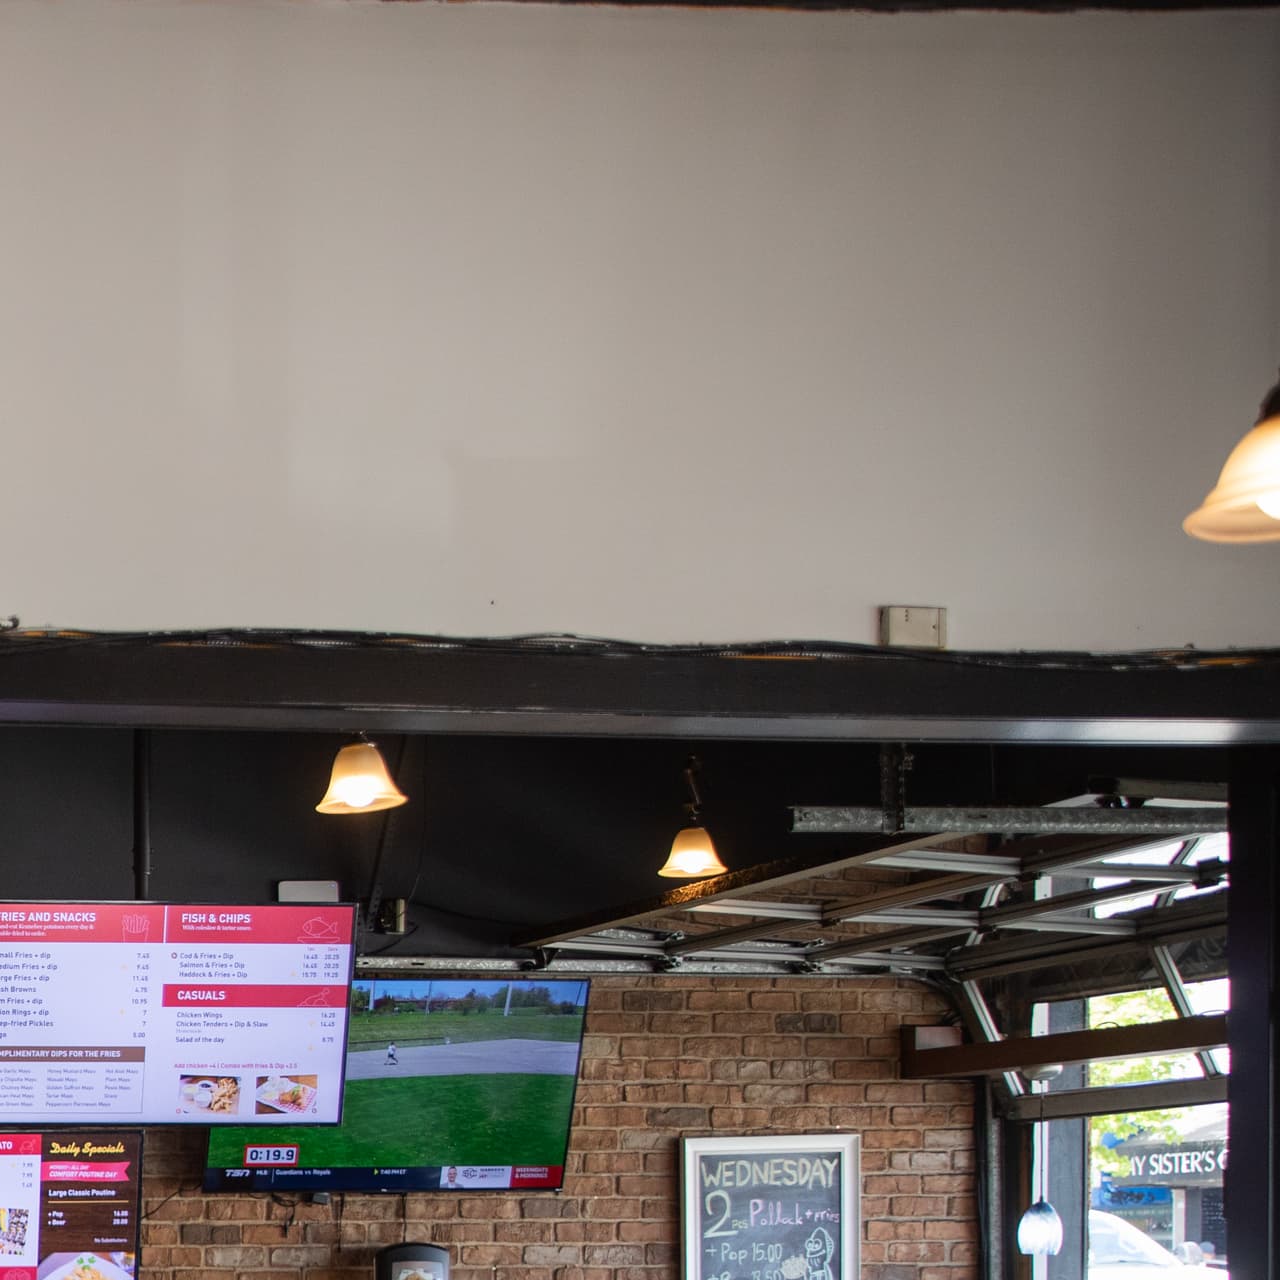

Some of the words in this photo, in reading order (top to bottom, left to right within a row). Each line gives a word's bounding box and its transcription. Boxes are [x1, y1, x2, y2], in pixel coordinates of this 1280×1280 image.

[28, 912, 51, 922] AND
[53, 912, 96, 922] SNACKS
[182, 914, 206, 923] FISH
[209, 914, 216, 923] &
[219, 914, 251, 923] CHIPS
[40, 952, 51, 960] dip
[47, 963, 58, 971] dip
[177, 991, 225, 1000] CASUALS
[51, 1050, 68, 1058] DIPS
[69, 1050, 83, 1058] FOR
[85, 1050, 98, 1058] THE
[100, 1050, 121, 1058] FRIES
[49, 1142, 80, 1157] Daily
[82, 1142, 125, 1157] Specials
[250, 1150, 294, 1161] 0:19.9
[1149, 1150, 1216, 1176] SISTER'S
[225, 1169, 250, 1177] TSN
[701, 1158, 838, 1190] WEDNESDAY
[48, 1189, 67, 1198] Large
[704, 1189, 739, 1239] 2
[750, 1199, 803, 1227] Pollock
[721, 1243, 748, 1264] Pop
[752, 1242, 782, 1262] 15.00
